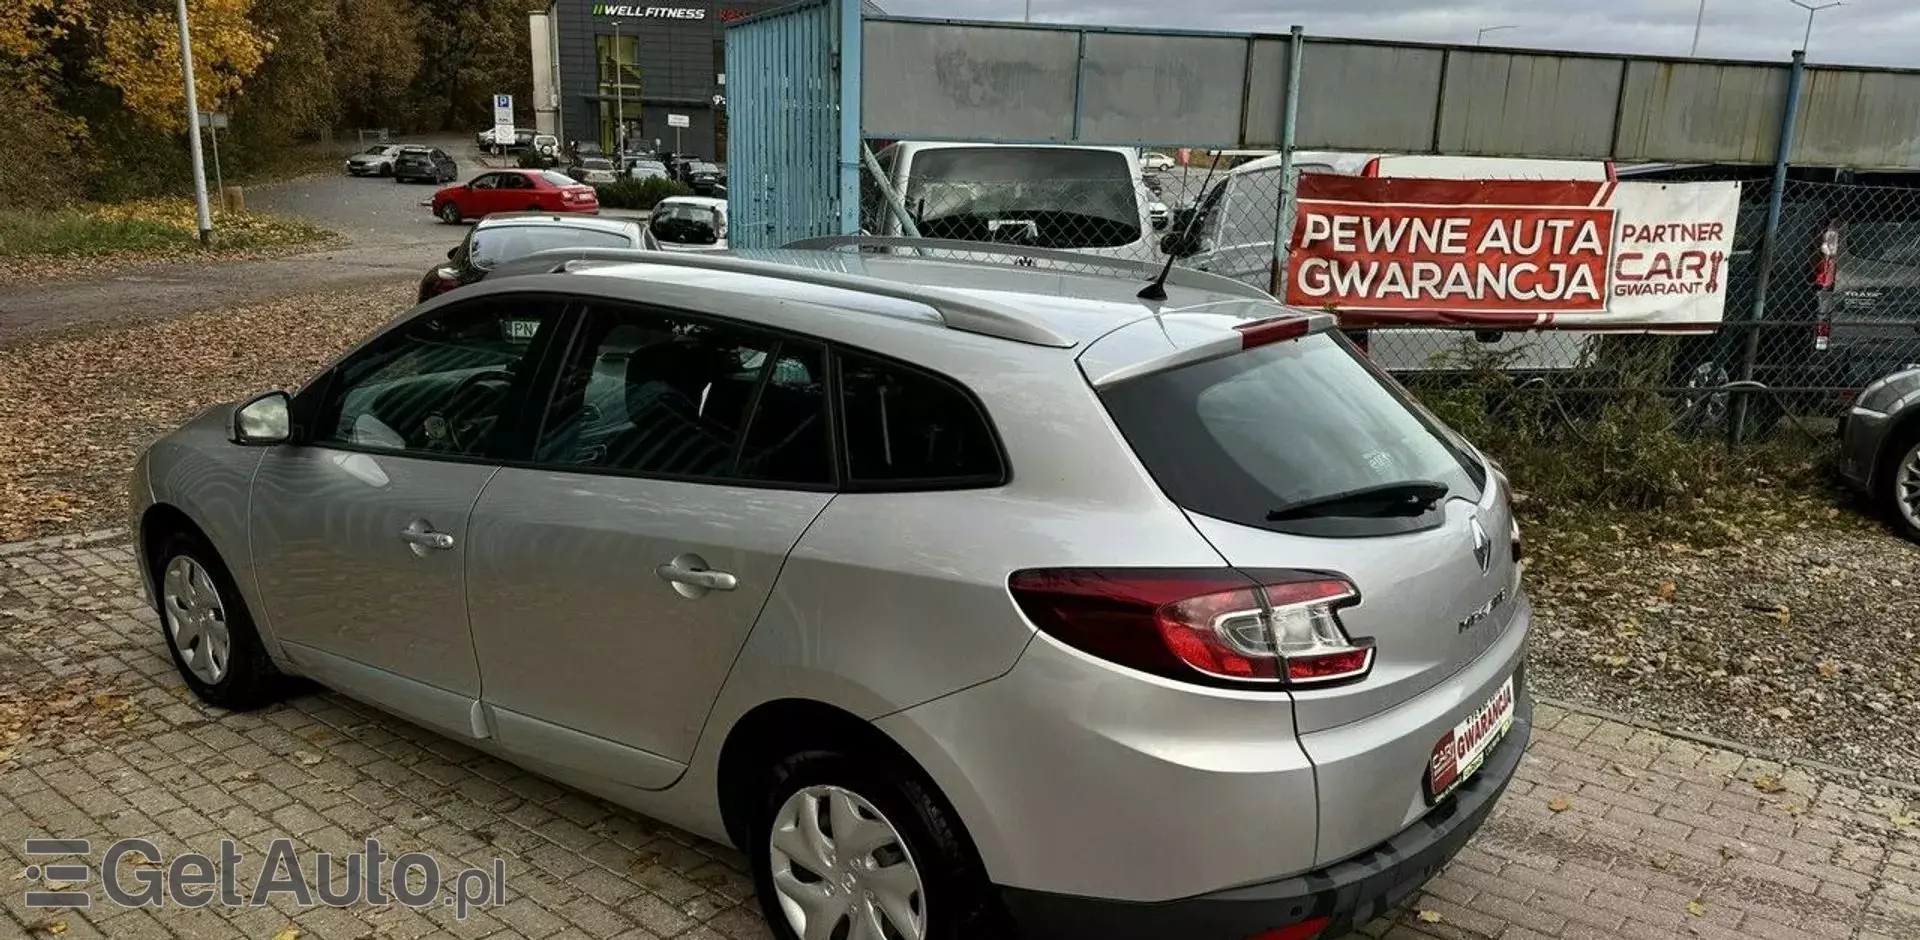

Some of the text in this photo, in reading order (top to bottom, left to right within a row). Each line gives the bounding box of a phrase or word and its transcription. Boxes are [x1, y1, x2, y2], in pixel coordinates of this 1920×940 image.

[604, 4, 644, 17] WELL
[645, 7, 706, 19] FITNESS
[1300, 213, 1604, 256] PEWNE AUTA
[1621, 222, 1724, 243] PARTNER
[1297, 256, 1600, 300] GWARANCJA
[1615, 250, 1707, 280] CAR
[1614, 282, 1703, 297] GWARANT
[1457, 683, 1512, 760] GWARANCJA
